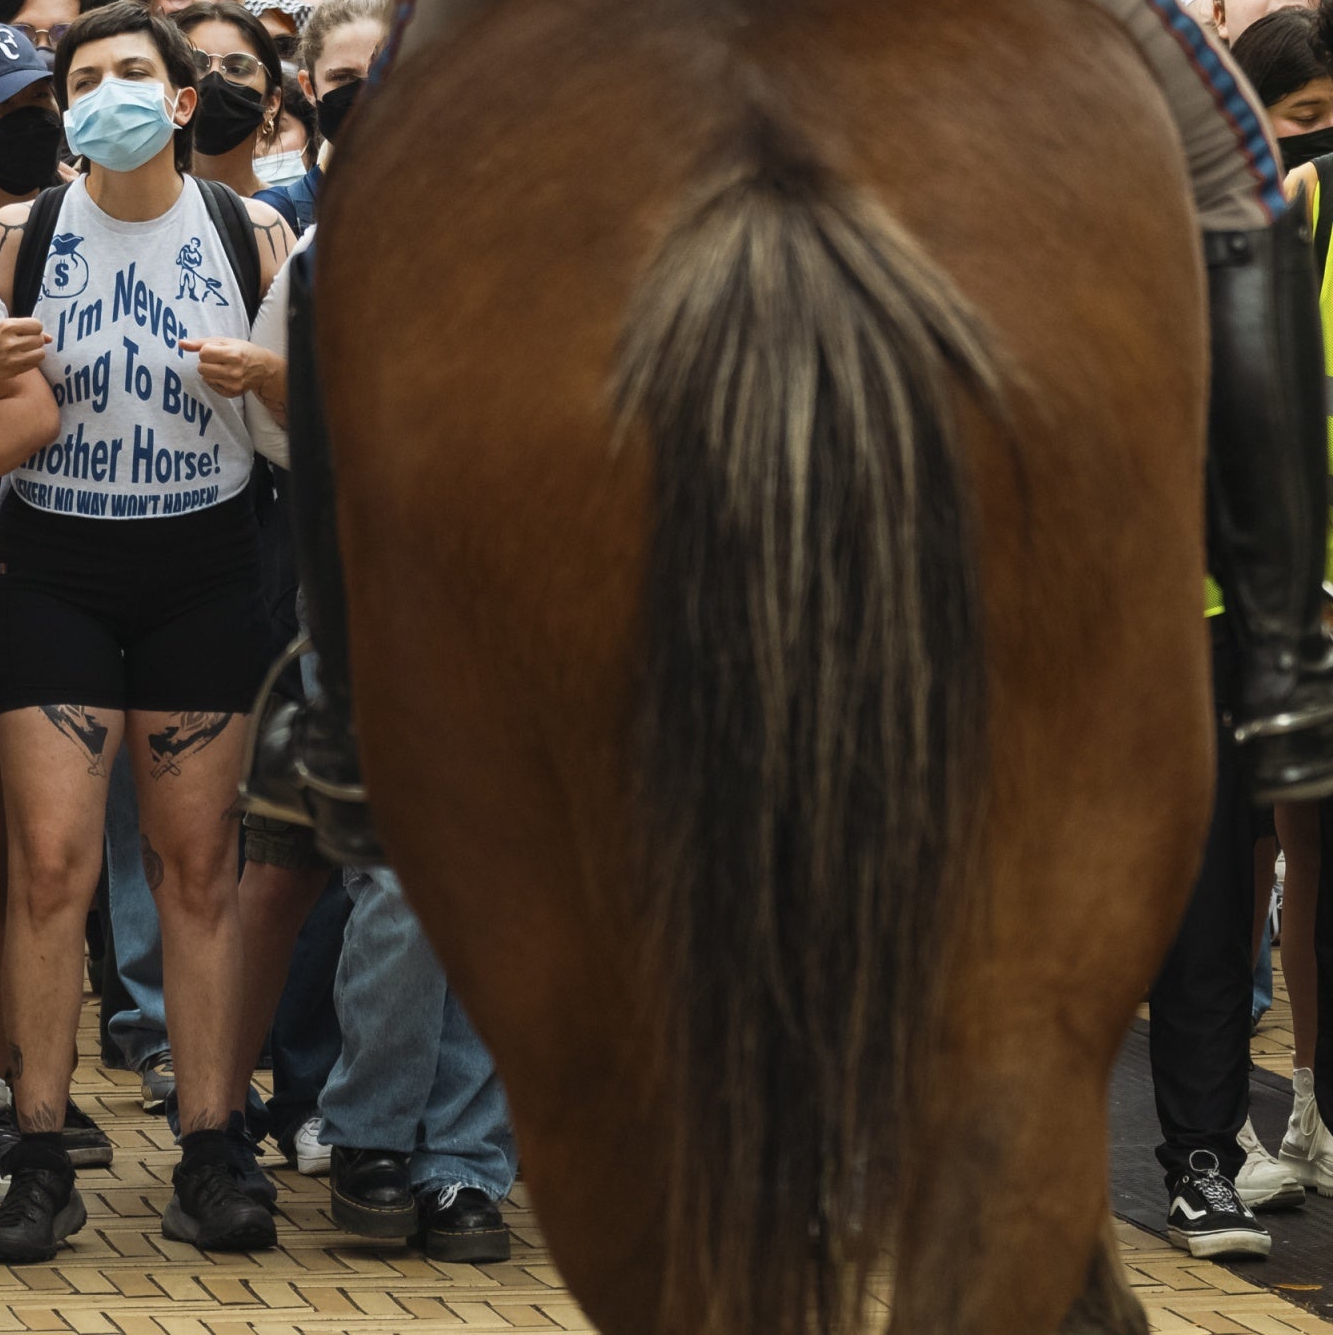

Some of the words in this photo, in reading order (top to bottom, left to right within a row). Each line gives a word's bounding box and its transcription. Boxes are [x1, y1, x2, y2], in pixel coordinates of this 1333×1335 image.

[56, 299, 103, 353] I'm
[112, 261, 188, 358] Never
[53, 350, 111, 413] oing
[123, 336, 152, 401] To
[162, 366, 213, 437] Buy
[20, 422, 123, 483] nother
[131, 424, 221, 484] Horse!
[54, 487, 74, 513] NO
[77, 490, 109, 517] WAY
[111, 493, 161, 517] WON'T
[162, 485, 219, 515] HAPPEN!
